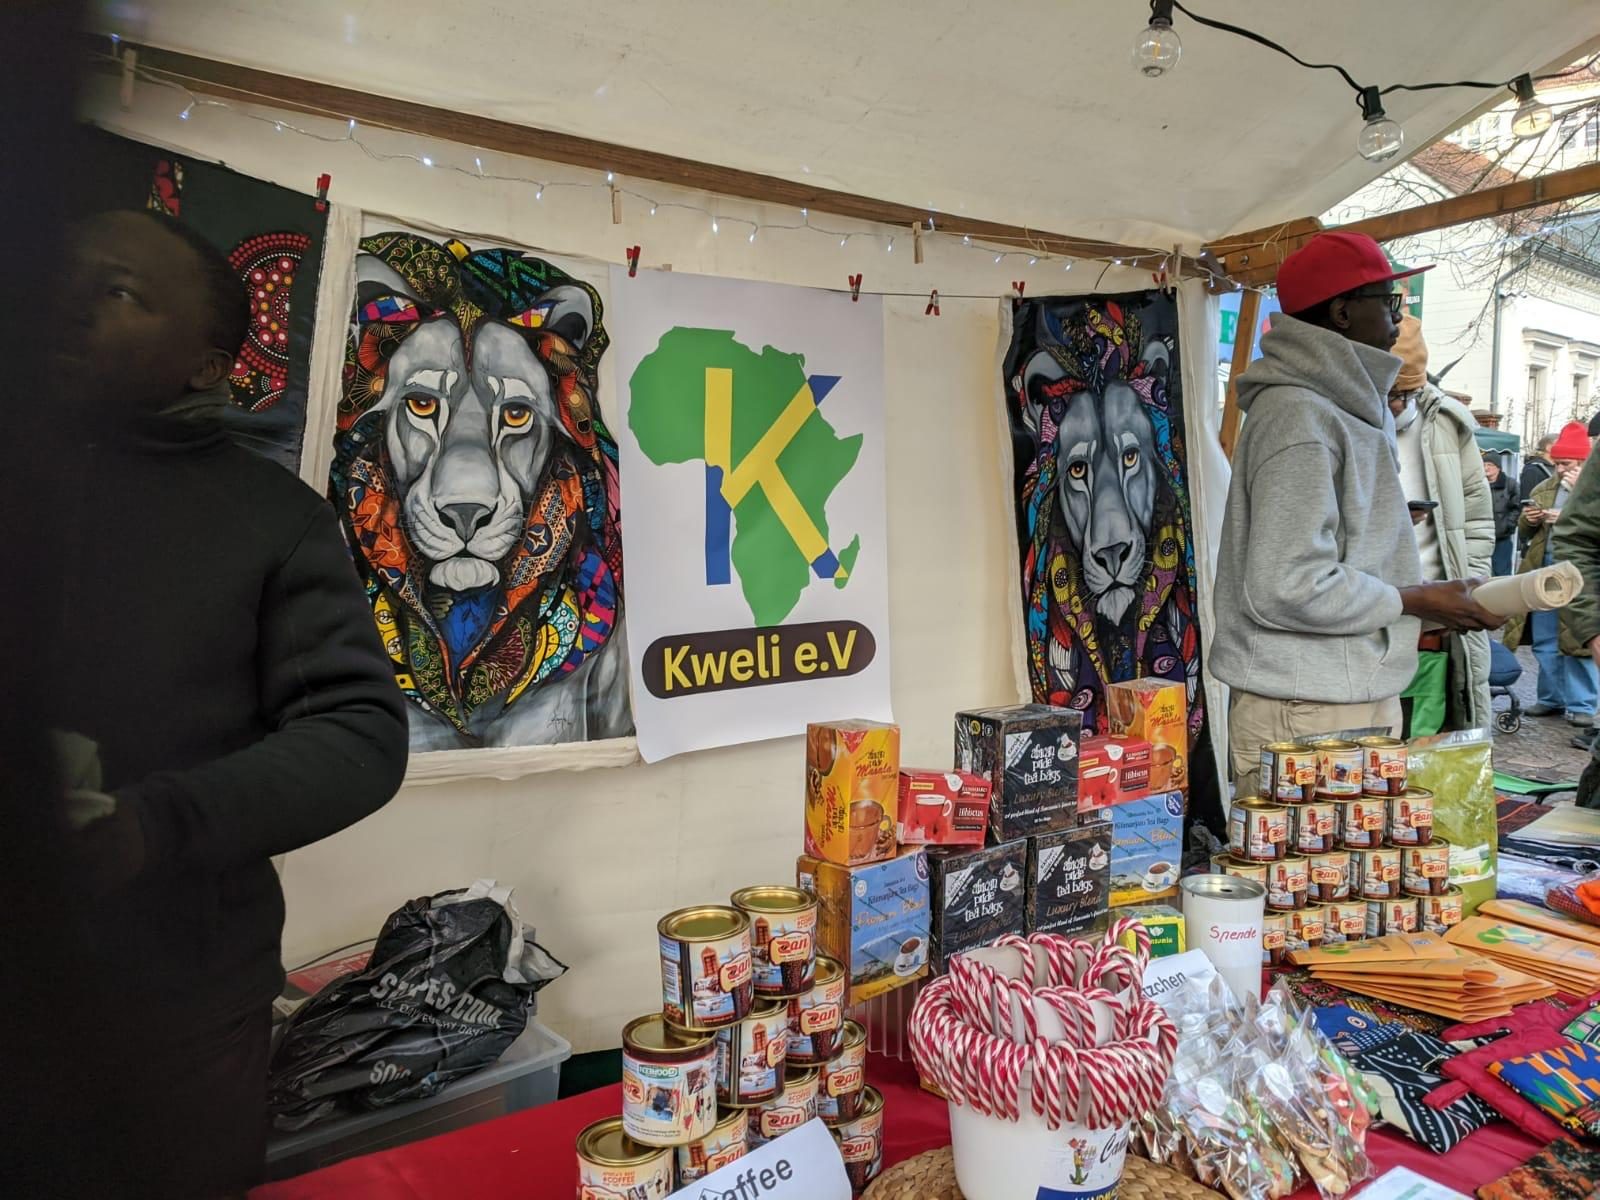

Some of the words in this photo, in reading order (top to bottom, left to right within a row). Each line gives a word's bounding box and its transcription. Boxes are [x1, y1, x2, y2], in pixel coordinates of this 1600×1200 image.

[663, 634, 781, 691] Kweli
[793, 630, 857, 673] e.V
[1032, 758, 1053, 772] pride
[1024, 771, 1038, 785] tea
[1039, 769, 1061, 784] bags
[1065, 869, 1085, 883] pride
[1315, 870, 1338, 879] Zan
[972, 878, 998, 895] african
[1056, 884, 1070, 898] tea
[1071, 880, 1094, 895] bags
[974, 892, 995, 906] pride
[965, 906, 979, 923] tea
[981, 901, 1004, 917] bags
[1210, 926, 1257, 943] Spende
[777, 938, 808, 954] Zan
[726, 958, 752, 979] Zan
[1142, 971, 1187, 999] tzchen
[806, 1009, 836, 1025] Zan
[832, 1071, 860, 1087] Zan
[767, 1113, 801, 1128] Zan
[842, 1141, 871, 1156] Zan
